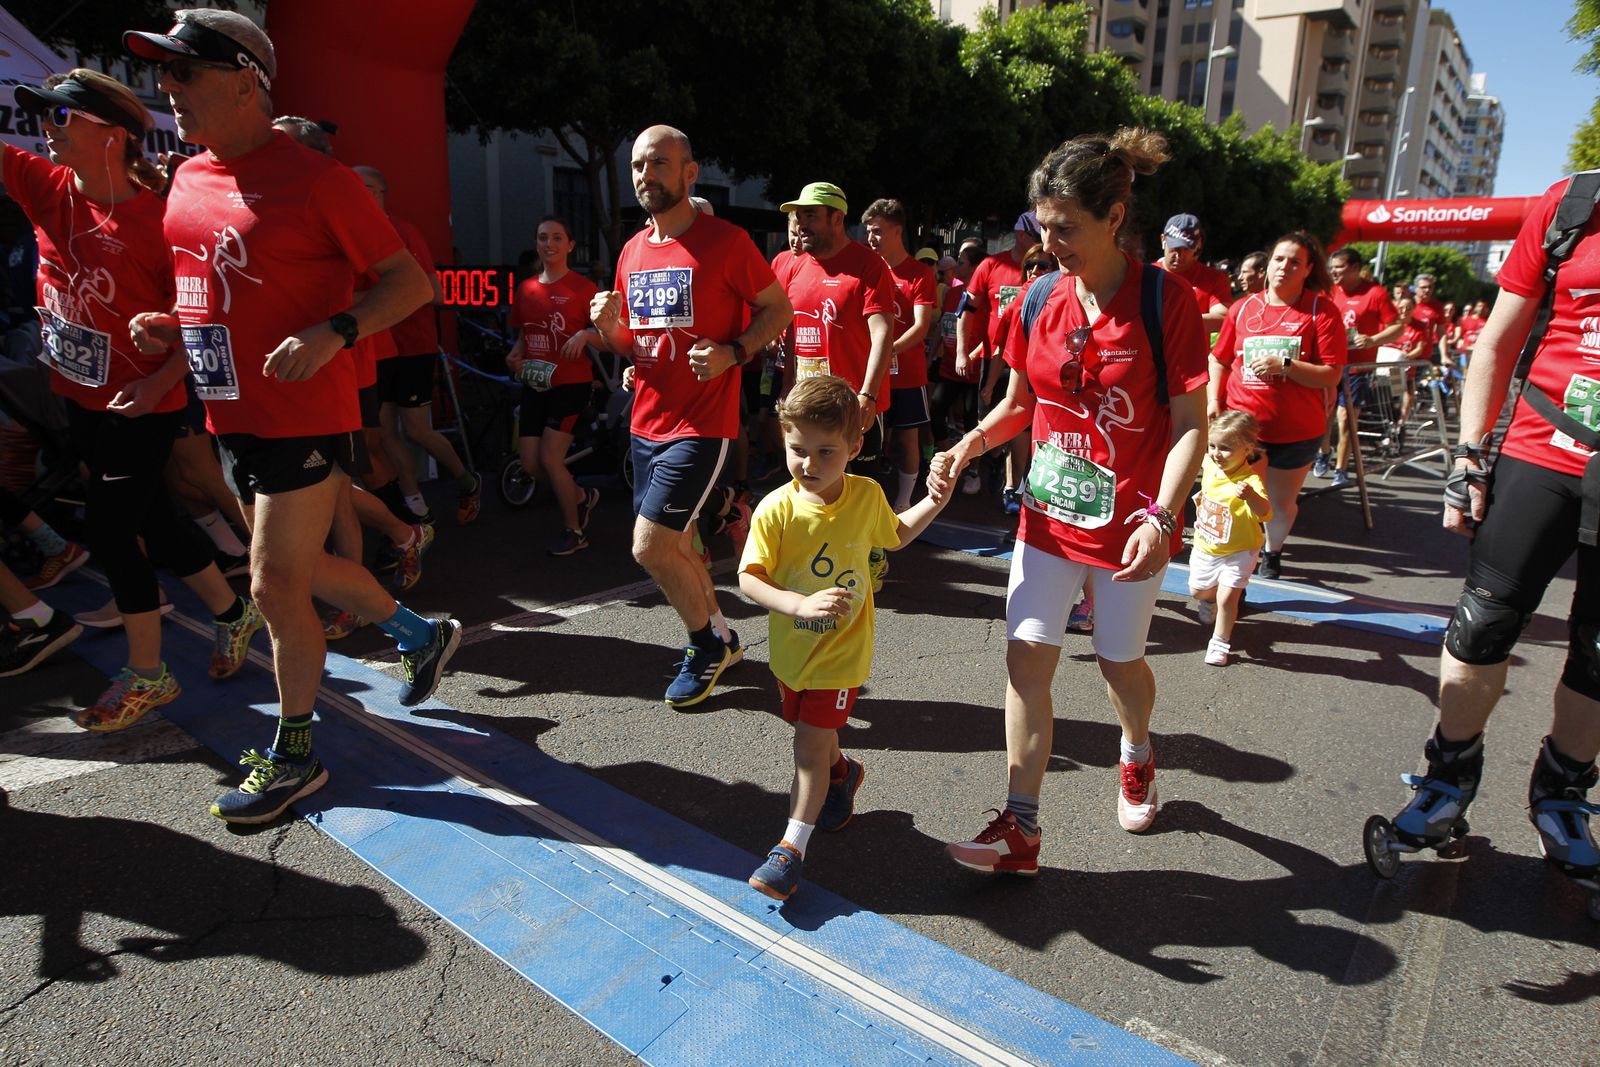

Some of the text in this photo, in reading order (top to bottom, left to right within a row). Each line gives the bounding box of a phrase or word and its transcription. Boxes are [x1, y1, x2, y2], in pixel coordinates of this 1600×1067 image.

[1392, 206, 1493, 222] Santander
[633, 286, 678, 308] 2199
[41, 327, 92, 367] 2092
[1104, 348, 1138, 357] Santander
[303, 459, 327, 469] adidas
[1035, 465, 1097, 503] 1259
[1050, 494, 1076, 511] ENCANI
[811, 542, 834, 578] 6
[835, 688, 848, 710] 8
